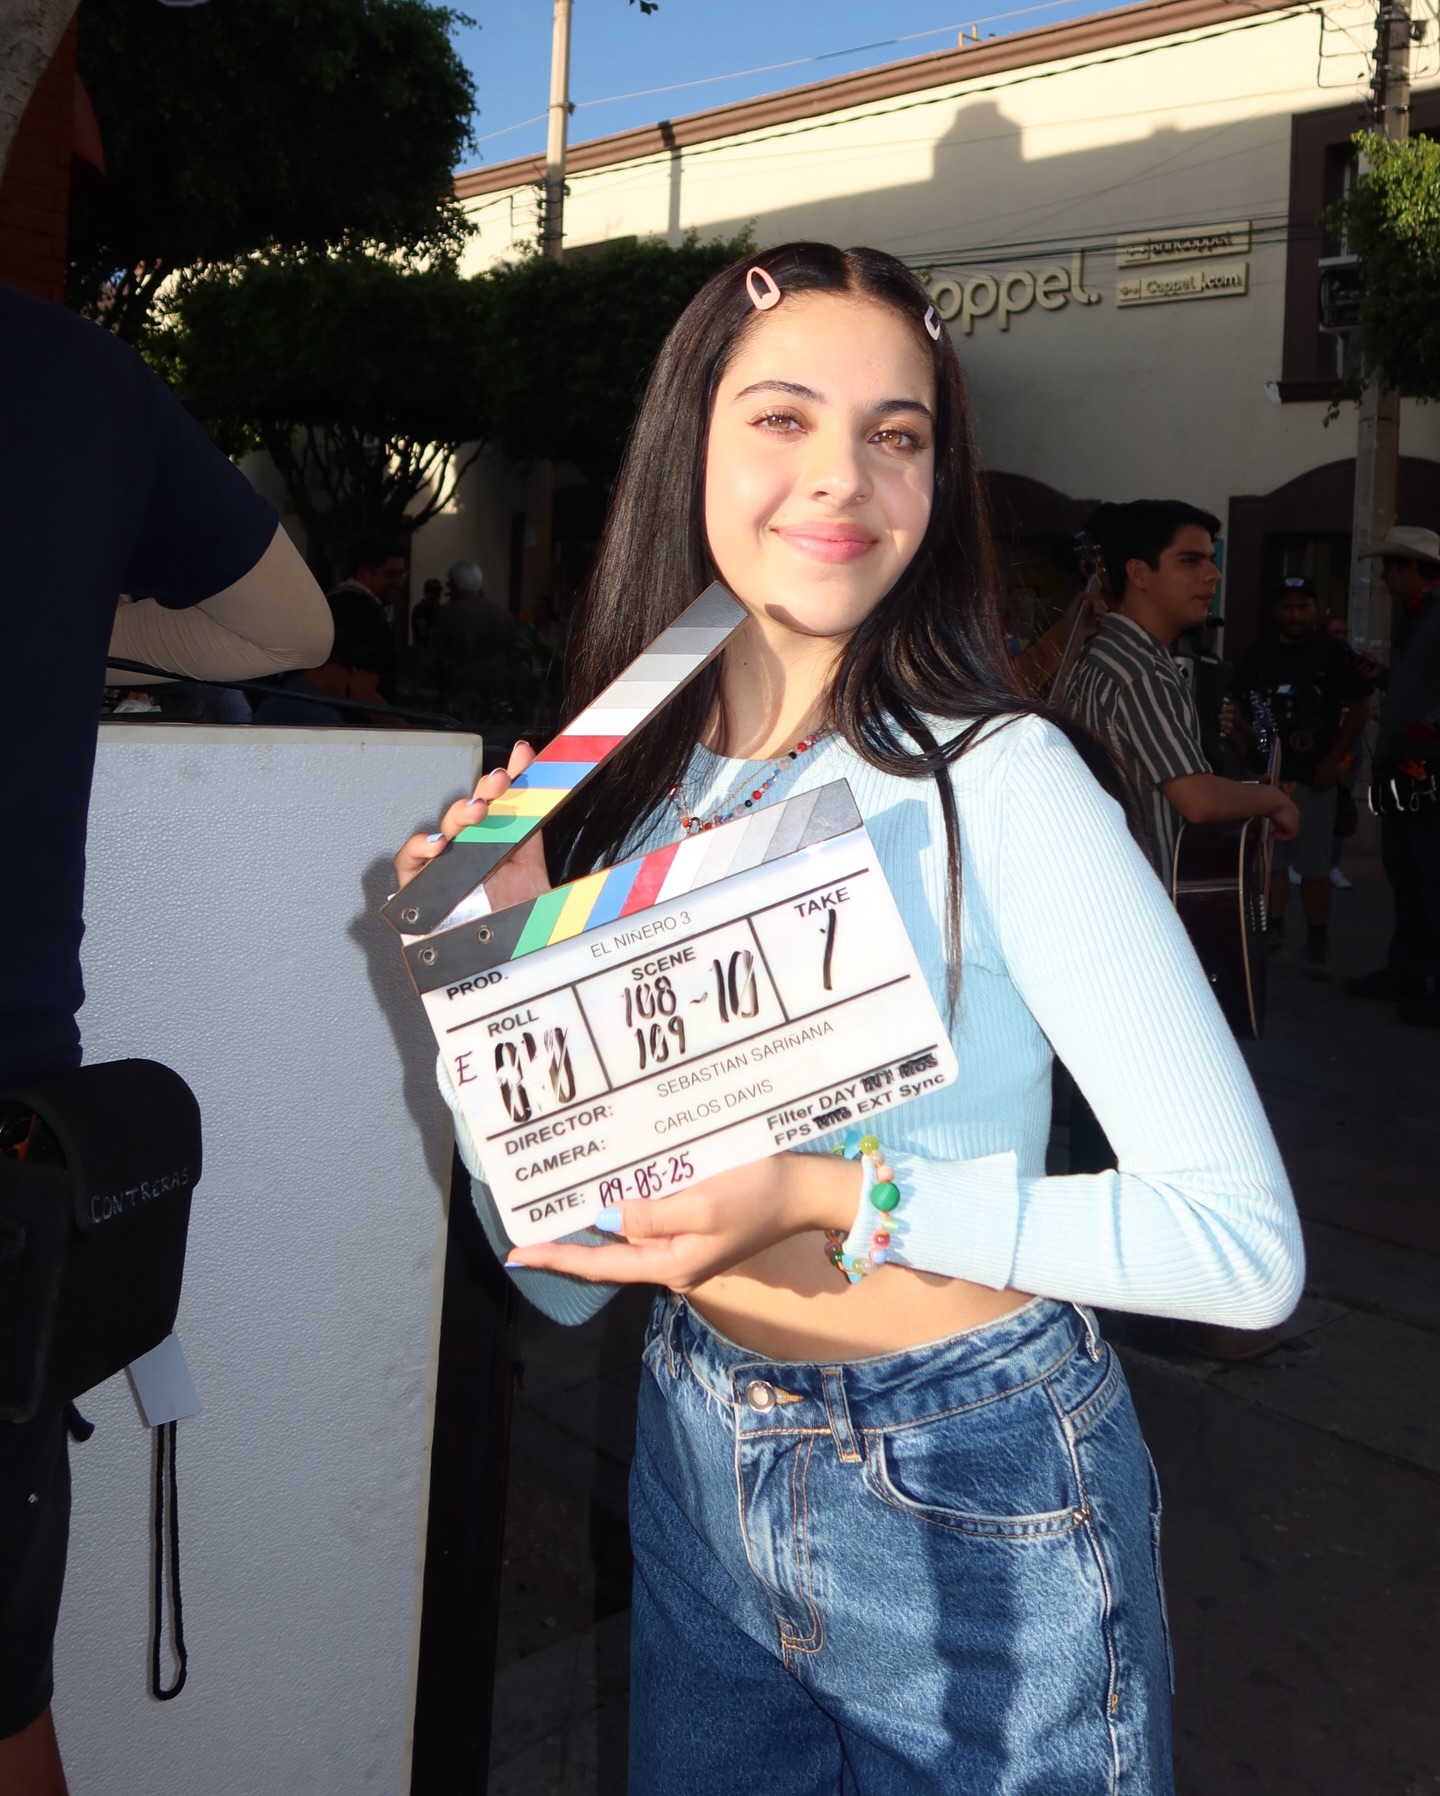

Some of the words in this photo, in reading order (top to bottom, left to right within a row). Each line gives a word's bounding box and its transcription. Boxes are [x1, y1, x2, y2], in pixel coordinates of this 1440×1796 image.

[918, 250, 1102, 335] oppel.
[793, 886, 850, 918] TAKE
[446, 971, 509, 1000] PROD.
[590, 942, 611, 958] EL
[614, 916, 676, 949] NIÑERO
[680, 911, 691, 925] 3
[631, 947, 696, 981] SCENE
[487, 1009, 540, 1037] ROLL
[621, 975, 677, 1028] 108
[455, 1051, 478, 1086] E
[634, 1015, 686, 1070] 109
[505, 1105, 614, 1155] DIRECTOR:
[657, 1053, 748, 1098] SEBASTIAN
[751, 1021, 835, 1062] SARIÑANA
[766, 1104, 814, 1131] Filter
[818, 1084, 857, 1111] DAY
[774, 1123, 811, 1146] FPS
[856, 1090, 892, 1114] EXT
[899, 1074, 945, 1098] Sync
[515, 1140, 606, 1182] CAMERA:
[654, 1099, 721, 1134] CARLOS
[724, 1079, 773, 1108] DAVIS
[91, 1167, 188, 1223] CONTRERAS
[599, 1151, 694, 1208] 09-05-25
[528, 1193, 586, 1223] DATE:
